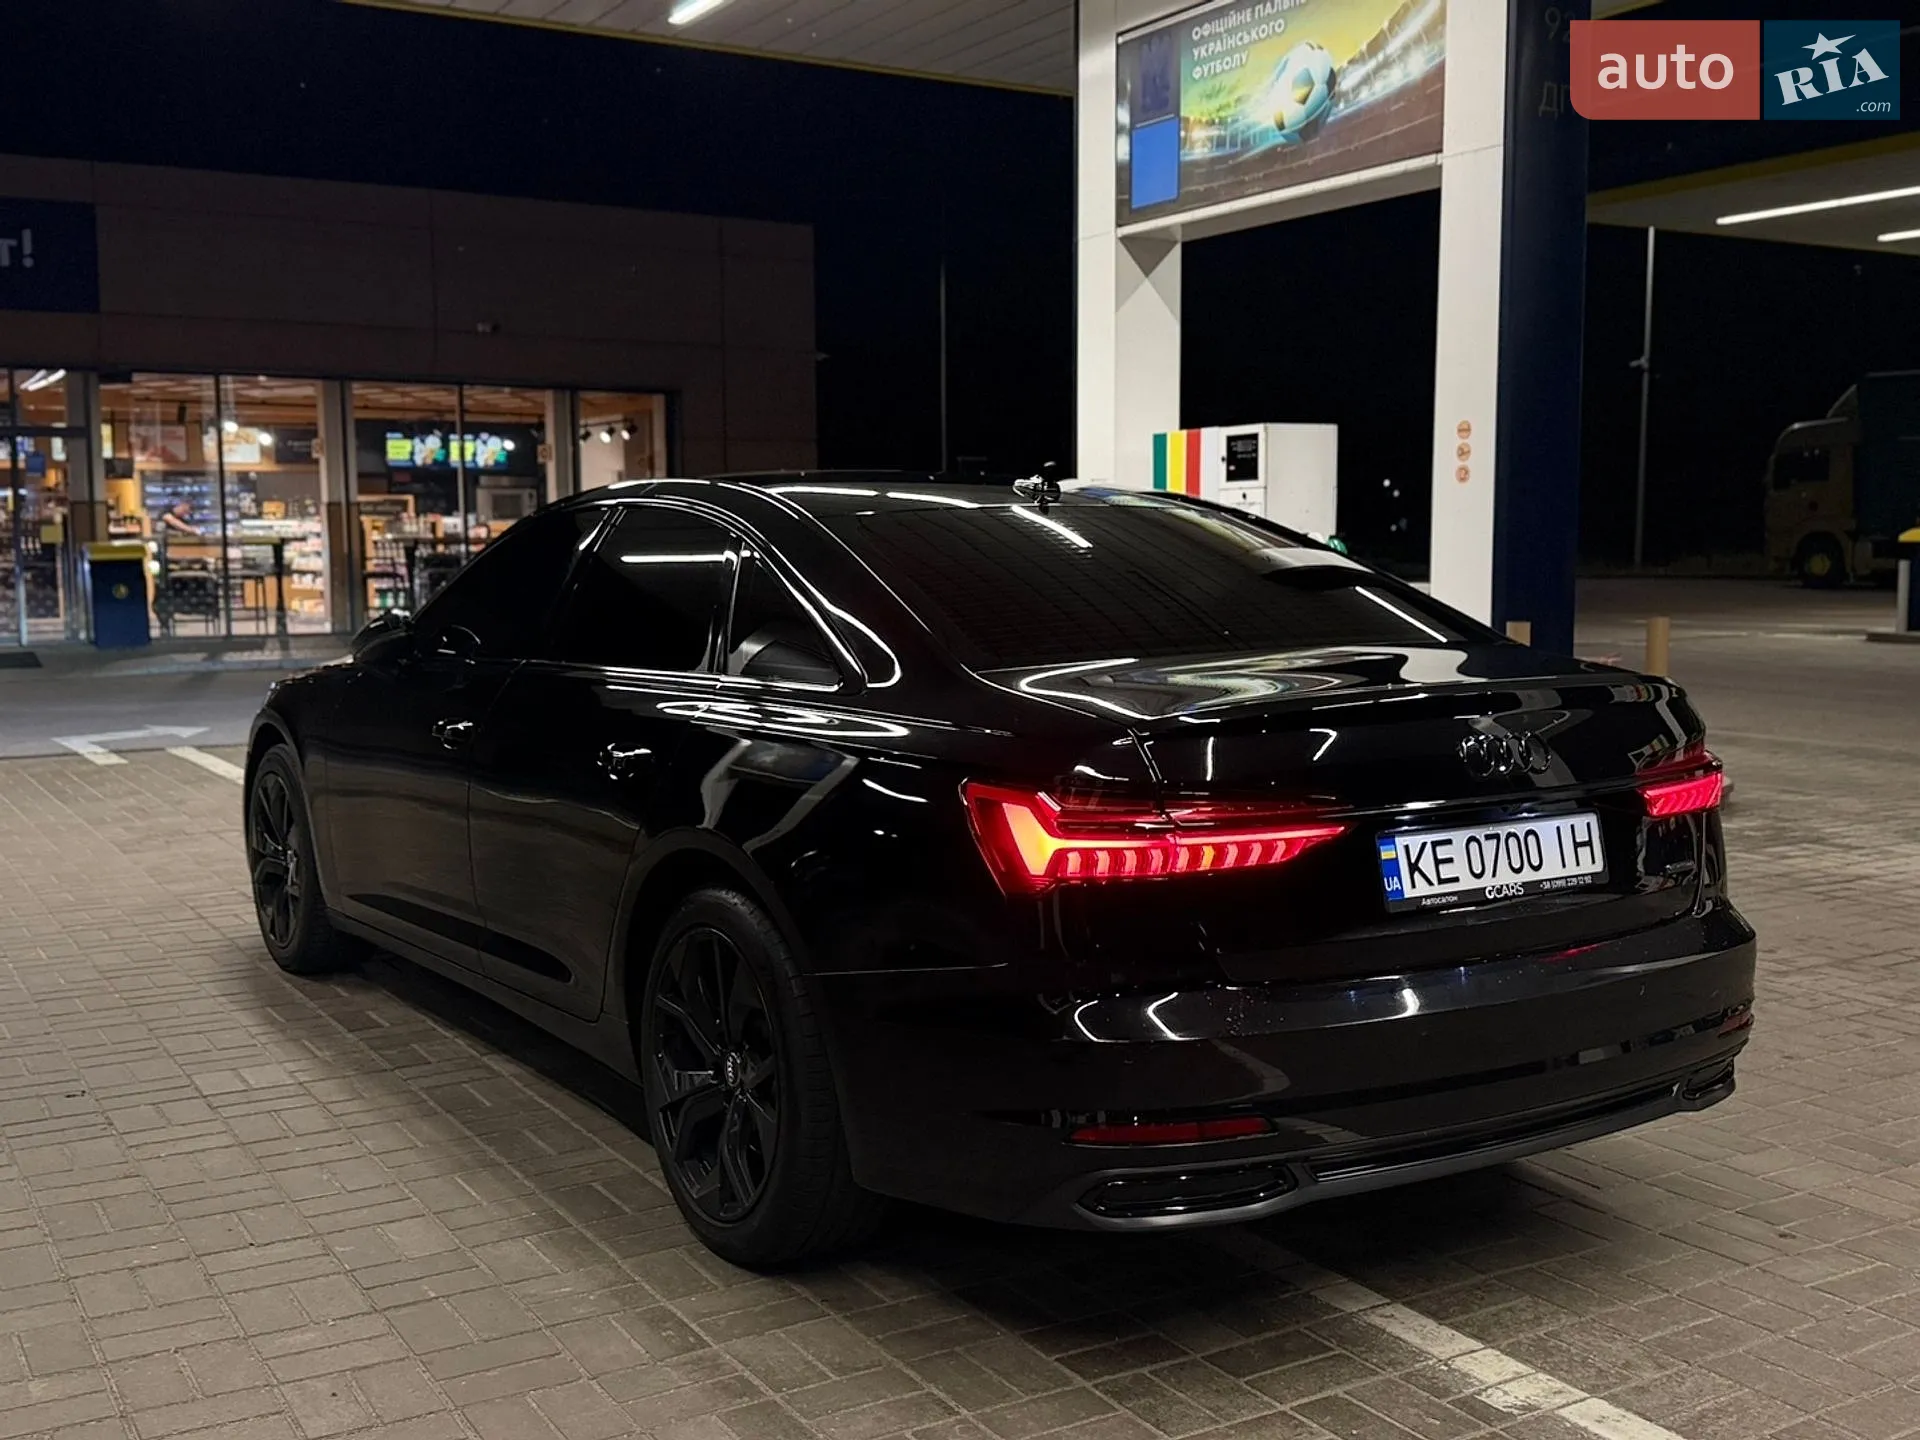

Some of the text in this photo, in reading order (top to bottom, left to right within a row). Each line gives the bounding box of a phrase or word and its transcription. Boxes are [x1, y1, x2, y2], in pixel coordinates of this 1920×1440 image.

[1192, 0, 1307, 41] ОФІЦІЙНЕ ПАЛЬН
[1192, 18, 1285, 62] УКРАЇНСЬКОГО
[1191, 50, 1249, 80] ФУТБОЛУ
[1403, 821, 1596, 889] KE 0700 IH
[1384, 876, 1402, 892] UA
[1485, 881, 1525, 899] GCARS
